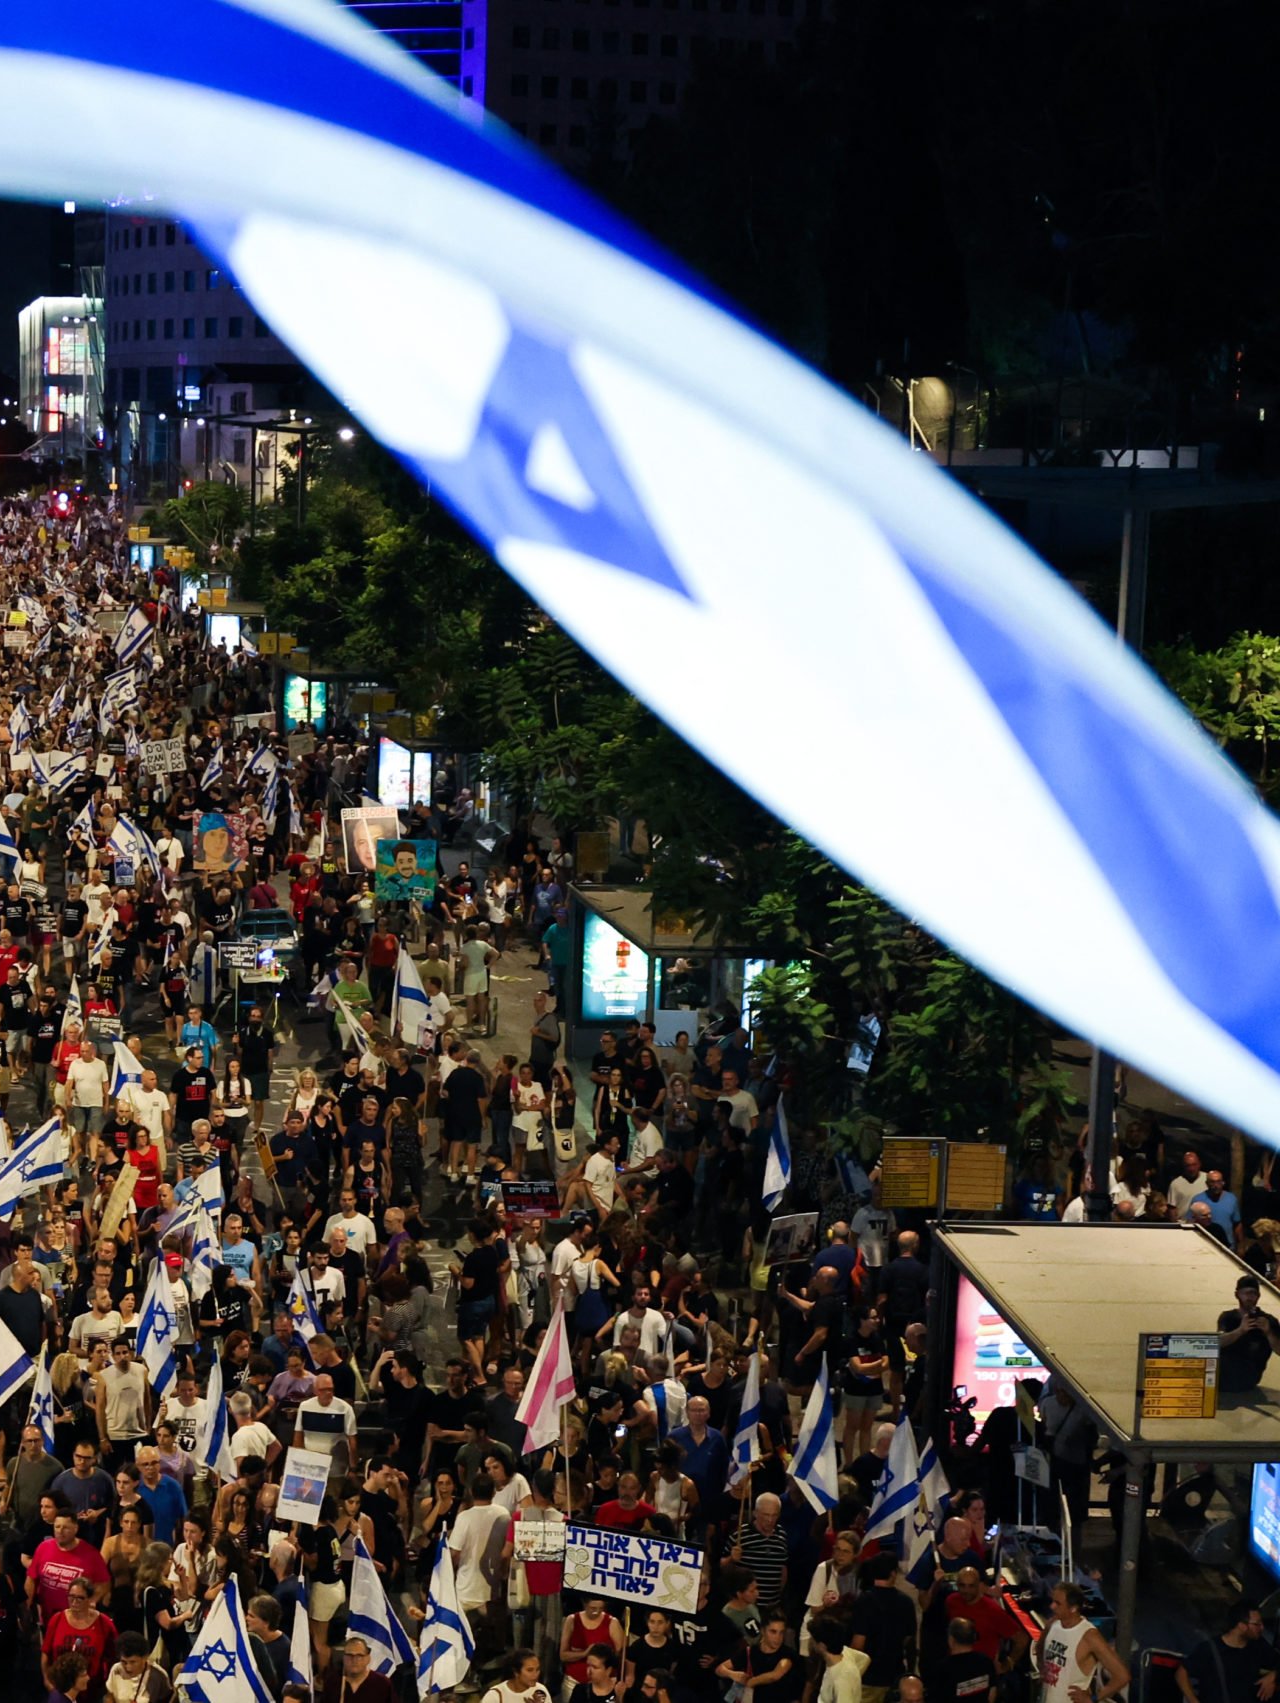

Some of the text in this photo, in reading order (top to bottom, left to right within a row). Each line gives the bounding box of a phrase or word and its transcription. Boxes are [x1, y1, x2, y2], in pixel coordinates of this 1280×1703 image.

[342, 807, 397, 819] BIBI ESCOBAR
[637, 1539, 703, 1569] בארץ
[591, 1569, 655, 1596] לאורח
